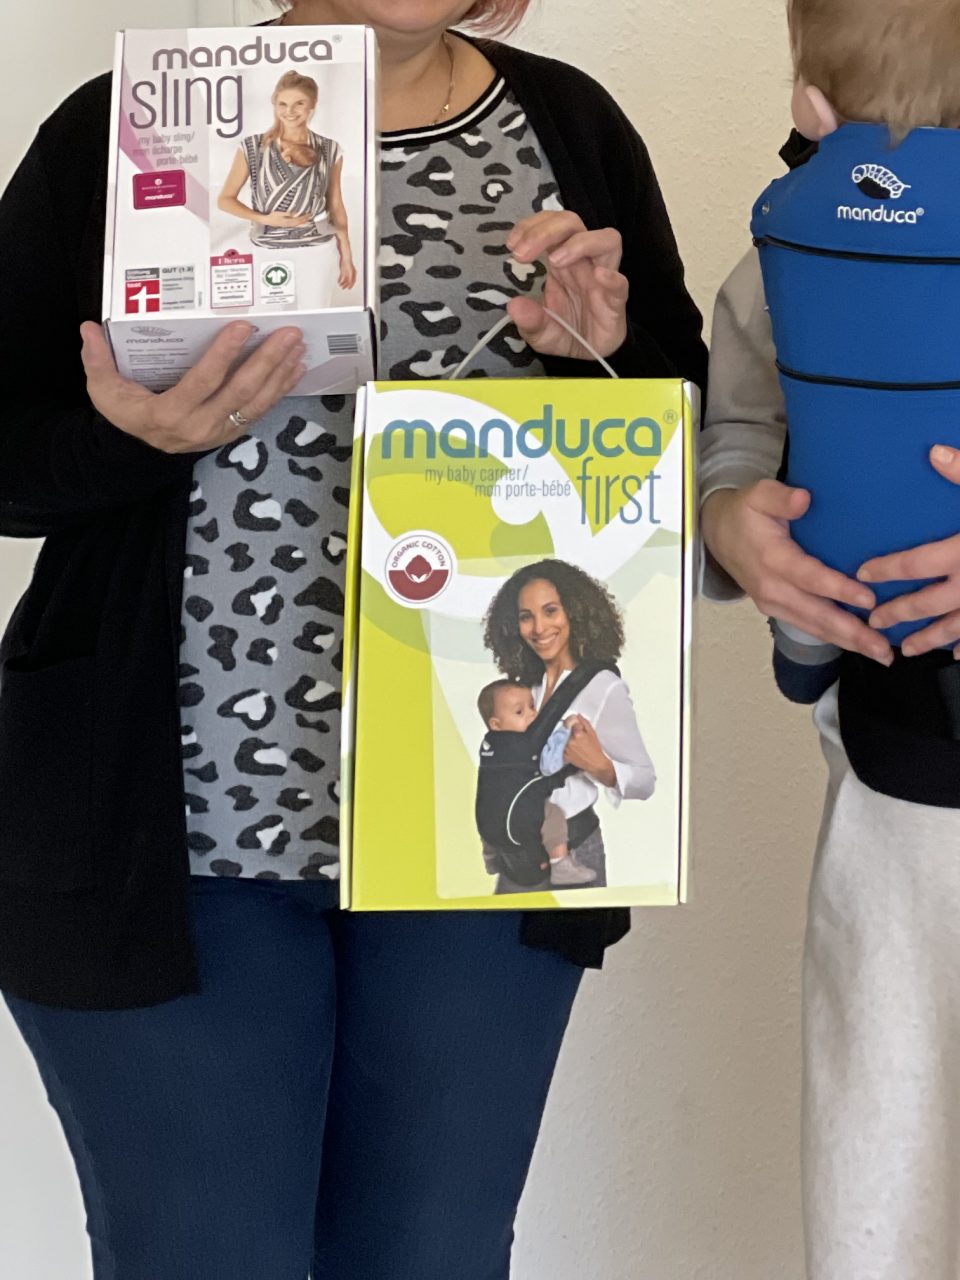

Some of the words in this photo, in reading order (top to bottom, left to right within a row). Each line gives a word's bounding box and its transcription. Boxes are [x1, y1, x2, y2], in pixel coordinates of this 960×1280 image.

[152, 35, 333, 70] manduca
[129, 71, 243, 139] sling
[837, 204, 917, 224] manduca
[381, 404, 662, 459] manduca
[424, 467, 443, 483] my
[446, 465, 477, 483] baby
[479, 464, 529, 482] carrier/
[474, 483, 501, 497] mon
[505, 480, 571, 500] porte-bébé
[576, 456, 662, 525] first
[391, 540, 420, 568] ORGANIC
[421, 541, 446, 567] COTTON
